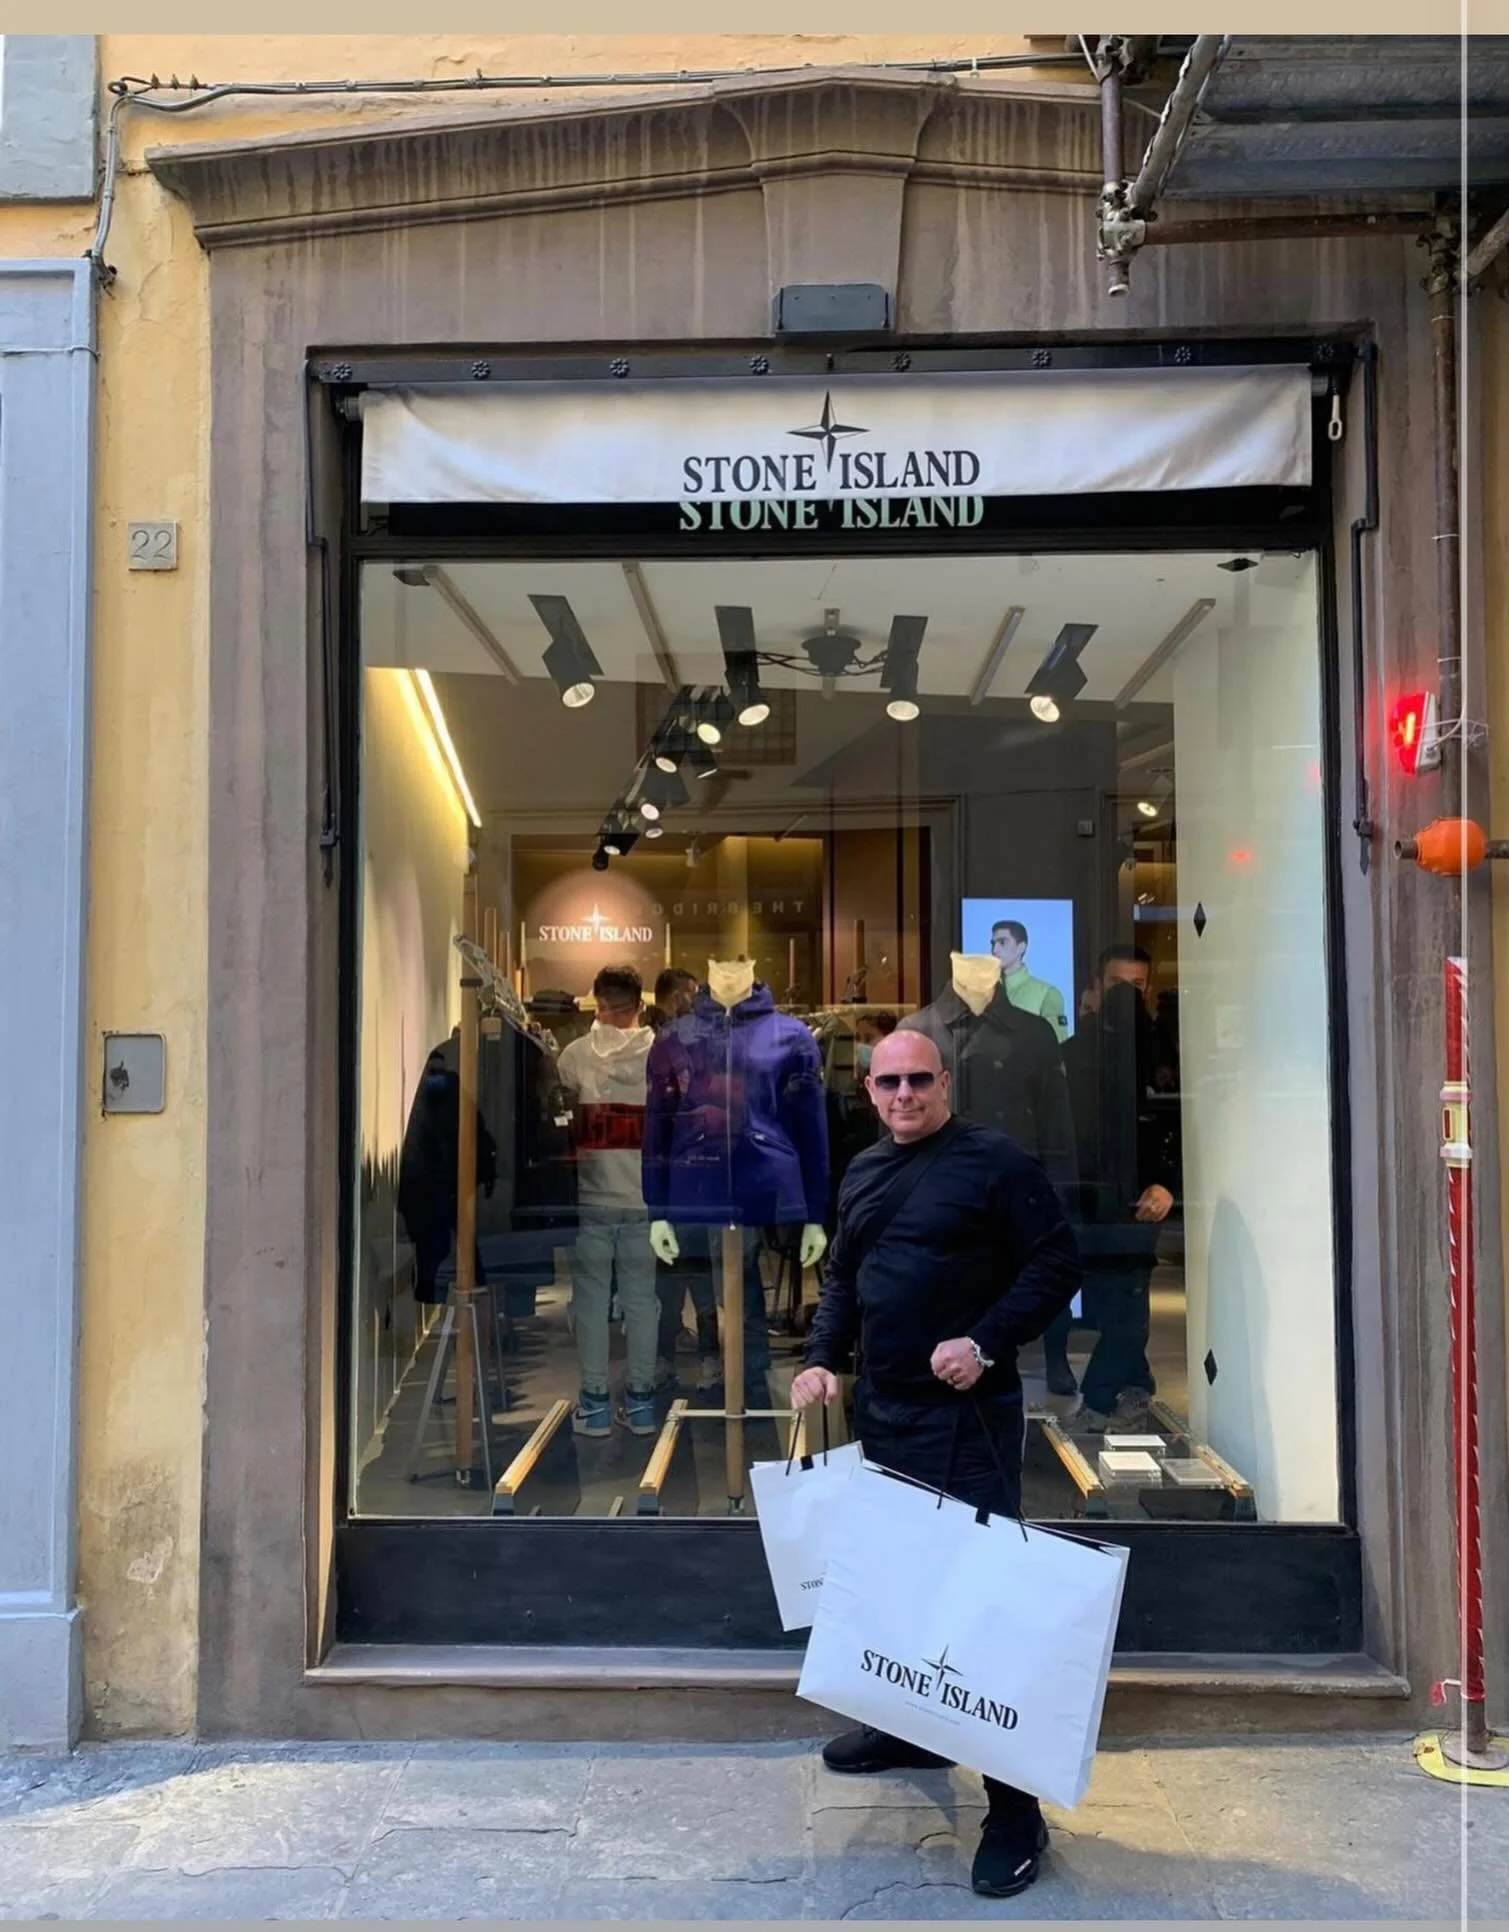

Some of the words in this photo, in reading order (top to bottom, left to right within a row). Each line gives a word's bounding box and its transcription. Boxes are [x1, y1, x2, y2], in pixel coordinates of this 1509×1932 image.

[682, 454, 817, 493] STONE
[839, 450, 980, 490] ISLAND
[679, 498, 819, 531] STONE
[841, 495, 984, 529] ISLAND
[131, 529, 172, 560] 22
[539, 925, 593, 942] STONE
[599, 925, 653, 942] ISLAND
[860, 1649, 932, 1697] STONE
[940, 1682, 1018, 1730] ISLAND
